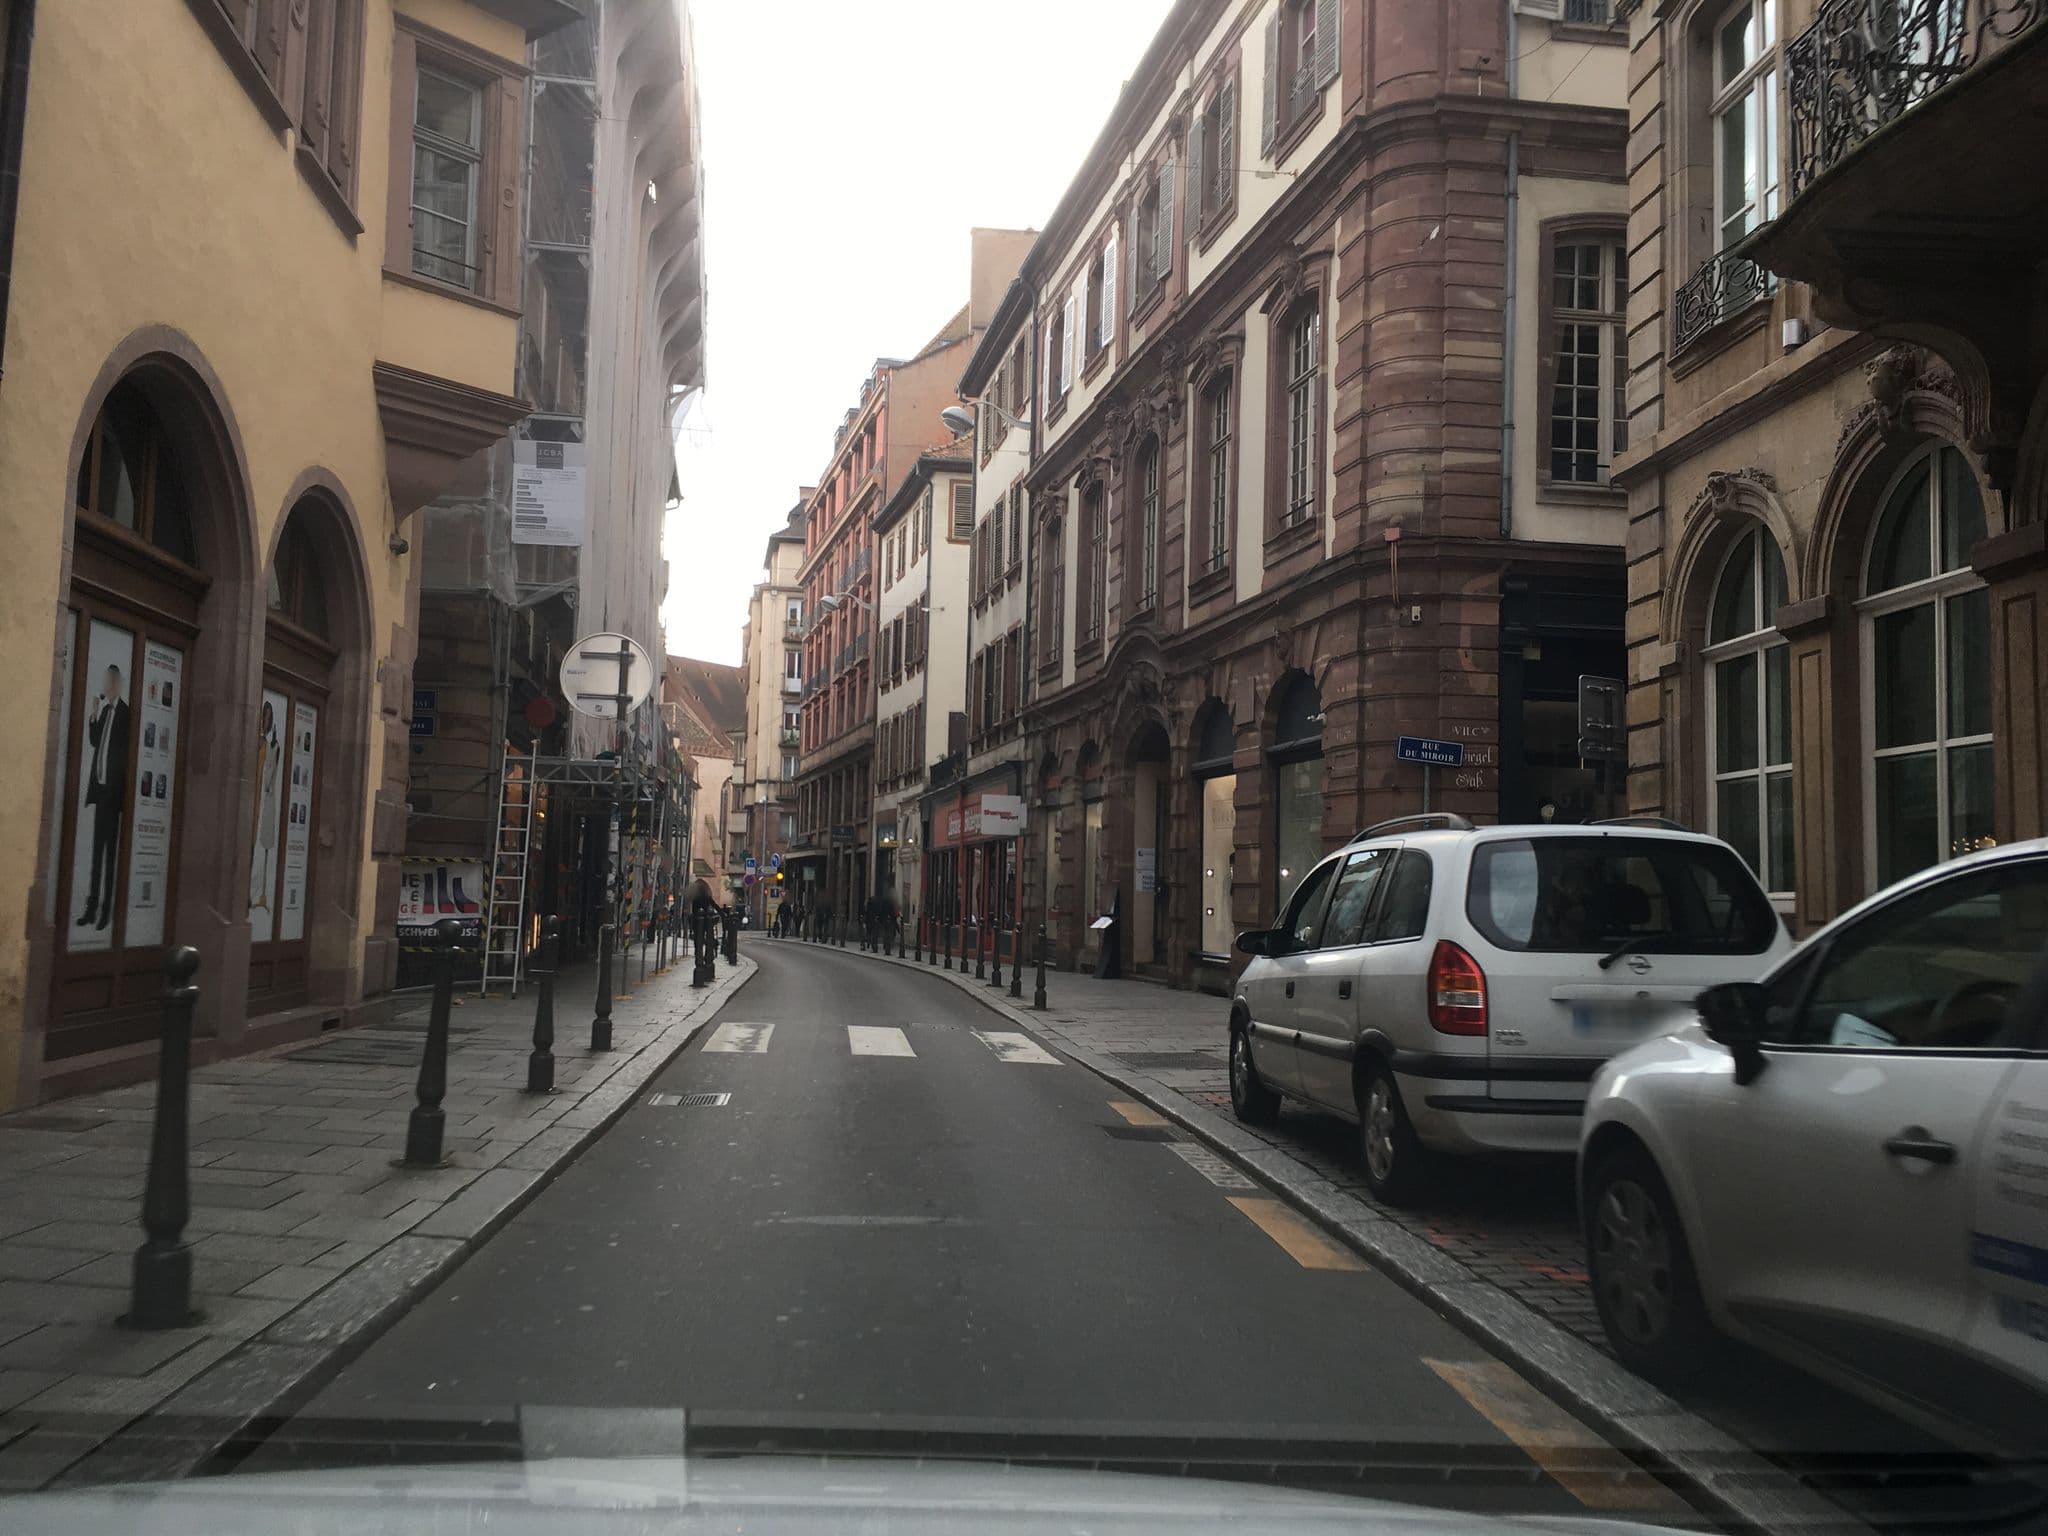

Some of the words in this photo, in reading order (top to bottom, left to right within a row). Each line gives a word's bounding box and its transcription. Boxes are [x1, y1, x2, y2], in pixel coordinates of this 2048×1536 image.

[1422, 741, 1440, 751] RUE
[1405, 749, 1418, 758] DU
[1421, 751, 1455, 763] MIROIR
